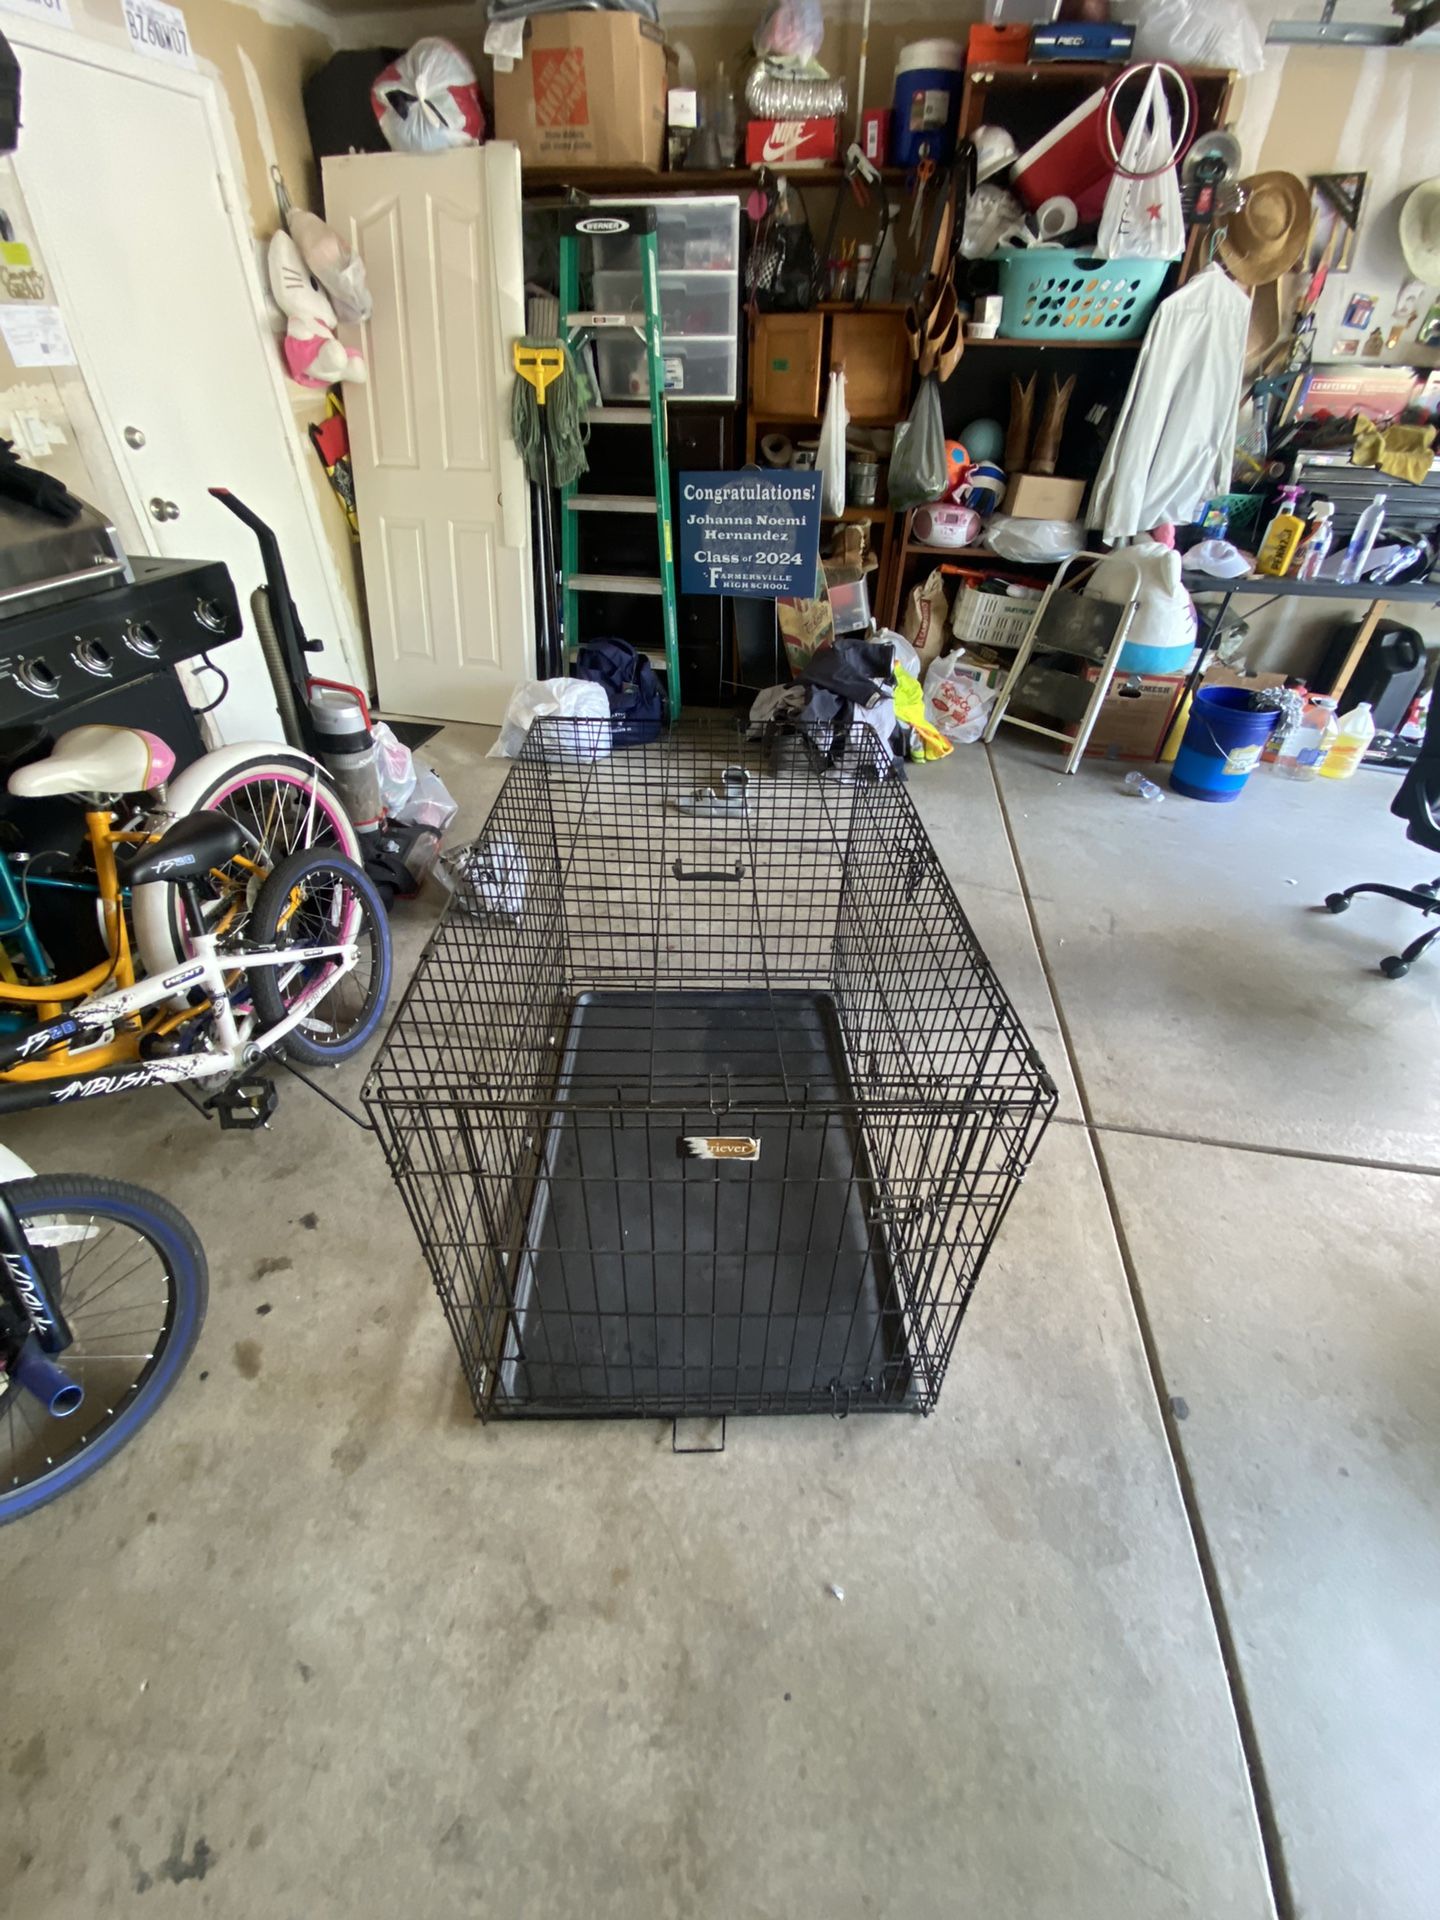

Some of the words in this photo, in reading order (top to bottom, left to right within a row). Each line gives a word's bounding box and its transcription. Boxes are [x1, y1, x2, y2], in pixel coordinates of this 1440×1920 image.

[769, 122, 806, 143] NIKE
[585, 222, 619, 230] WERNER
[684, 484, 816, 504] Congratulations!
[687, 514, 752, 525] Johanna
[756, 515, 806, 526] Noemi
[704, 530, 788, 541] Hernandez
[694, 551, 740, 564] Class
[755, 552, 802, 565] 2024
[709, 567, 792, 588] FARMERSVILLE
[723, 581, 750, 589] HIGH
[750, 582, 790, 590] SCHOOL
[164, 967, 203, 987] KENT
[50, 1071, 153, 1101] AMBUSH
[710, 1142, 749, 1153] riever
